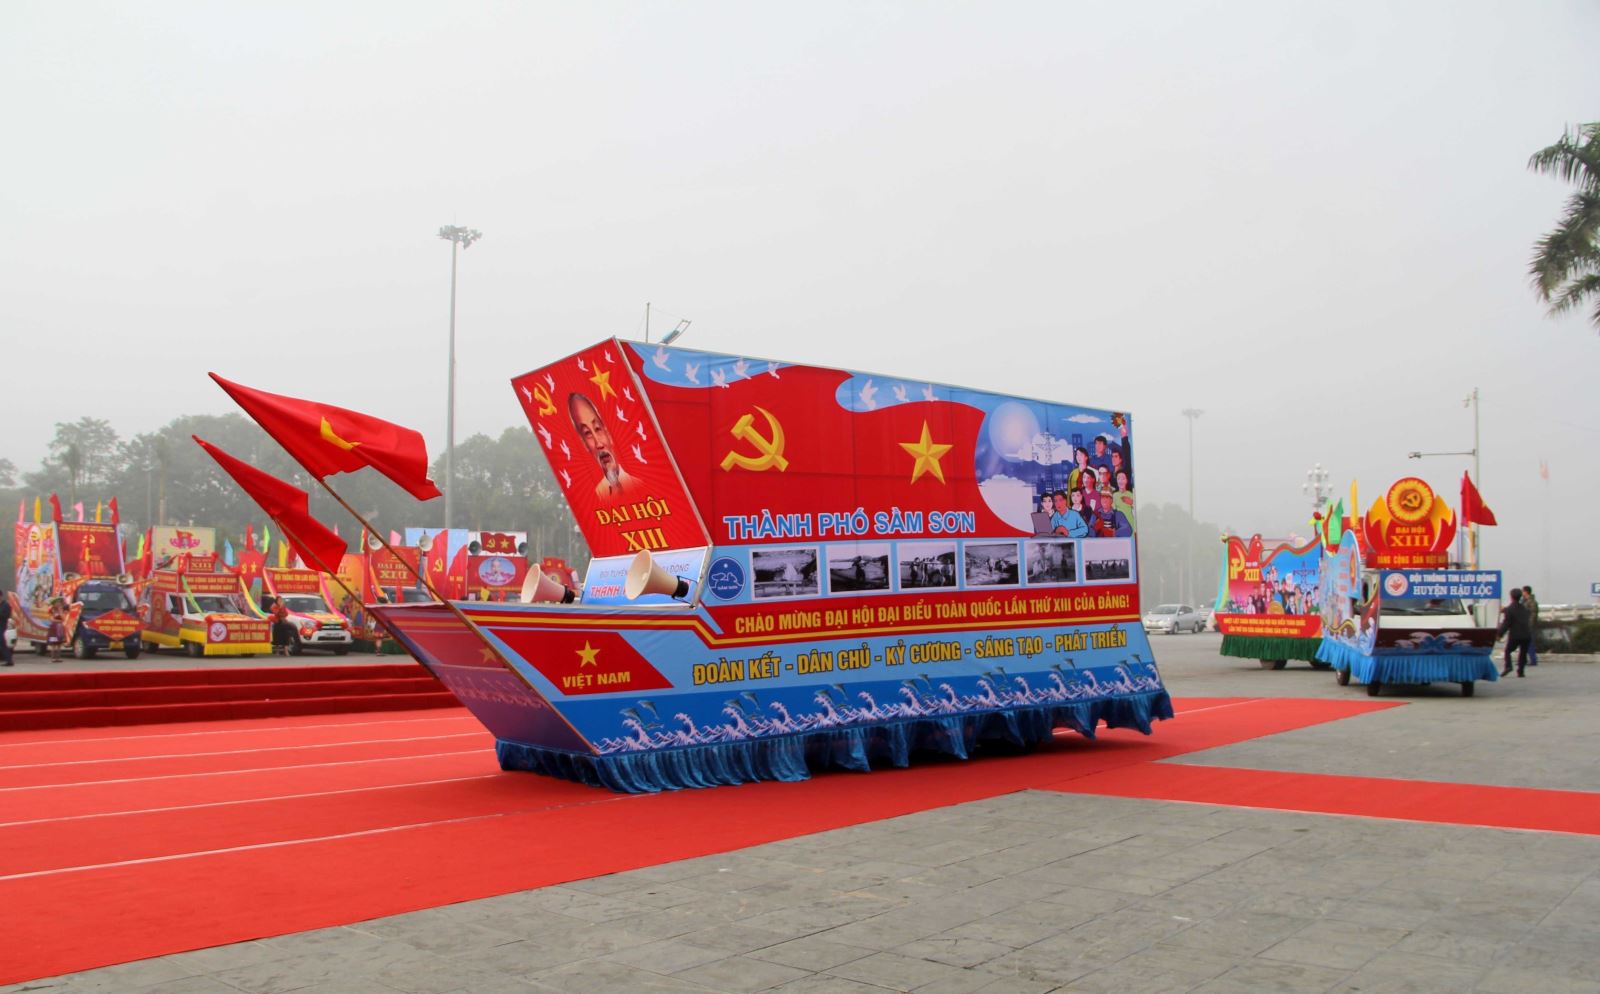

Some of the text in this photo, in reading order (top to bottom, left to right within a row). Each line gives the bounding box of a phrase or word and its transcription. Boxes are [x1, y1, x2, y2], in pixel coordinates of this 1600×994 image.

[595, 496, 671, 526] ĐẠI HỘI
[723, 507, 976, 539] THÀNH PHỐ SẦM SƠN
[621, 528, 669, 551] XIII
[1390, 535, 1429, 547] XIII
[1413, 583, 1493, 597] HUYỆN HẬU LỘC
[735, 612, 774, 634] CHÀO
[779, 609, 821, 630] MỪNG
[825, 609, 848, 629] ĐẠI
[852, 605, 875, 627] HỘI
[878, 606, 900, 625] ĐẠI
[904, 599, 931, 621] BIỂU
[935, 598, 967, 618] TOÀN
[970, 596, 1001, 618] QUỐC
[1029, 596, 1051, 613] THỨ
[1053, 597, 1071, 612] XIII
[1074, 592, 1095, 611] CỦA
[1098, 591, 1130, 609] ĐẢNG!
[692, 657, 744, 685] ĐOÀN
[748, 651, 782, 680] KẾT
[797, 649, 833, 674] DÂN
[837, 643, 871, 670] CHỦ
[885, 639, 906, 666] KỶ
[910, 640, 961, 664] CƯƠNG
[975, 634, 1013, 659] SÁNG
[1017, 636, 1043, 659] TẠO
[1055, 629, 1088, 652] PHÁT
[1090, 624, 1127, 650] TRIỂN
[562, 671, 631, 689] VIỆT NAM
